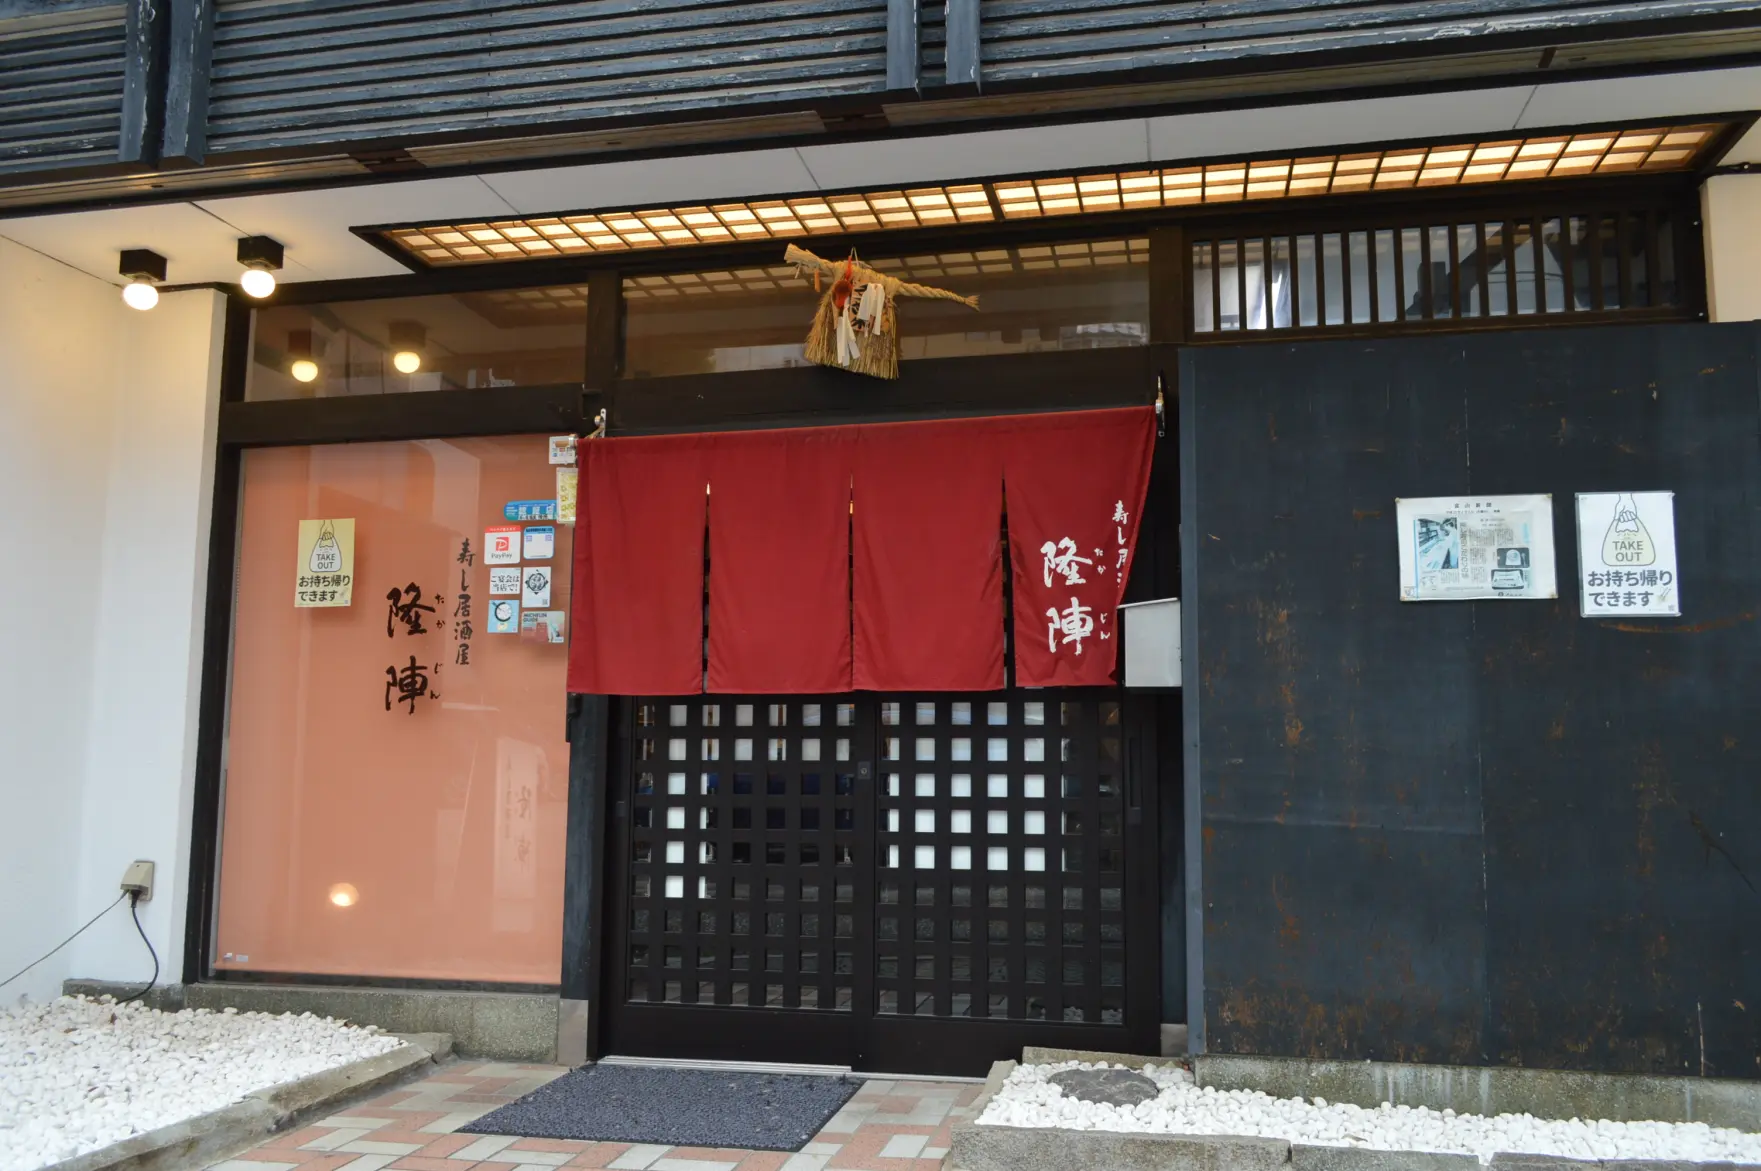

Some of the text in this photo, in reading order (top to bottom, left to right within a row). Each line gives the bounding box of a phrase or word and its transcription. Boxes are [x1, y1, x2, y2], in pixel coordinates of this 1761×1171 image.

[1612, 540, 1644, 551] TAKE
[316, 553, 336, 561] TAKE
[491, 552, 512, 560] PayPay
[1615, 551, 1642, 562] OUT
[317, 561, 334, 570] OUT
[298, 575, 351, 588] お持ち帰り
[1587, 569, 1673, 587] お持ち帰り
[298, 590, 338, 602] できます
[454, 537, 476, 666] 寿し居酒屋
[1588, 590, 1654, 607] できます
